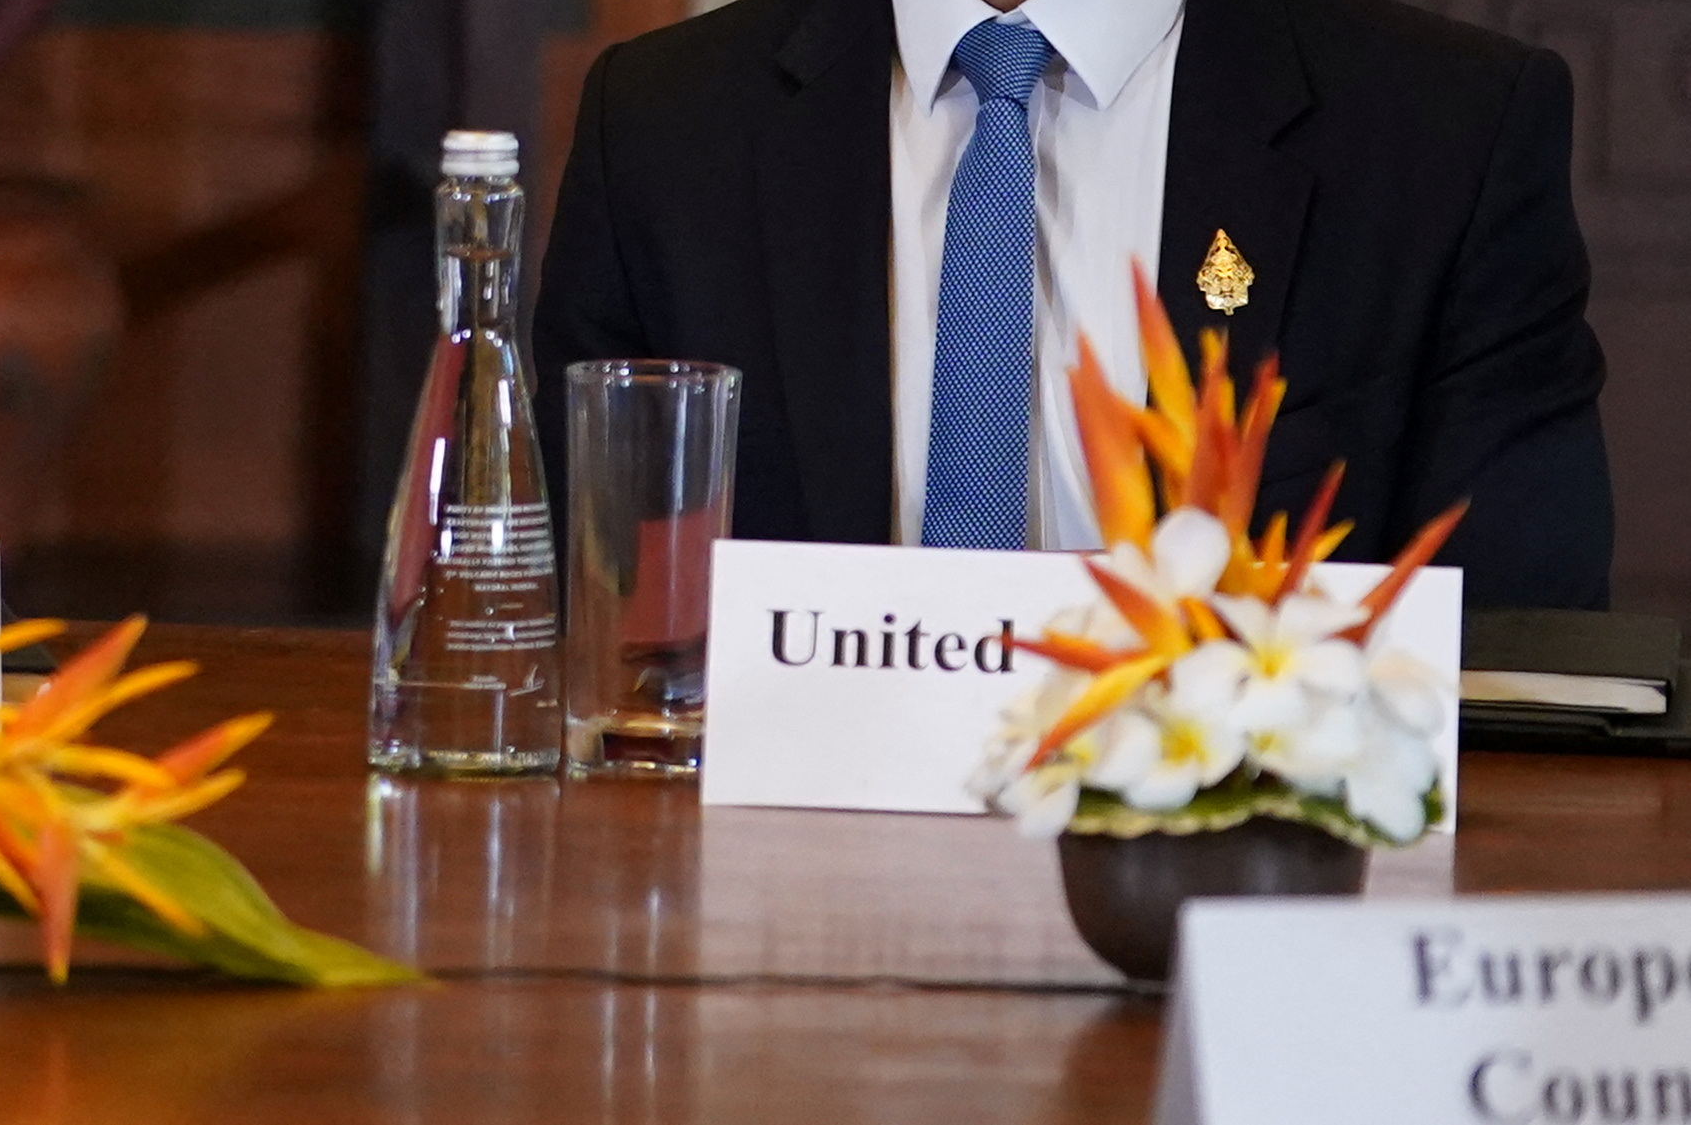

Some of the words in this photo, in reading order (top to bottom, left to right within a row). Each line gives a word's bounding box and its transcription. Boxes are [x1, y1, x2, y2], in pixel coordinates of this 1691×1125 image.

[766, 609, 1017, 675] United
[1411, 929, 1691, 1025] Europ
[1467, 1047, 1691, 1125] Coun
